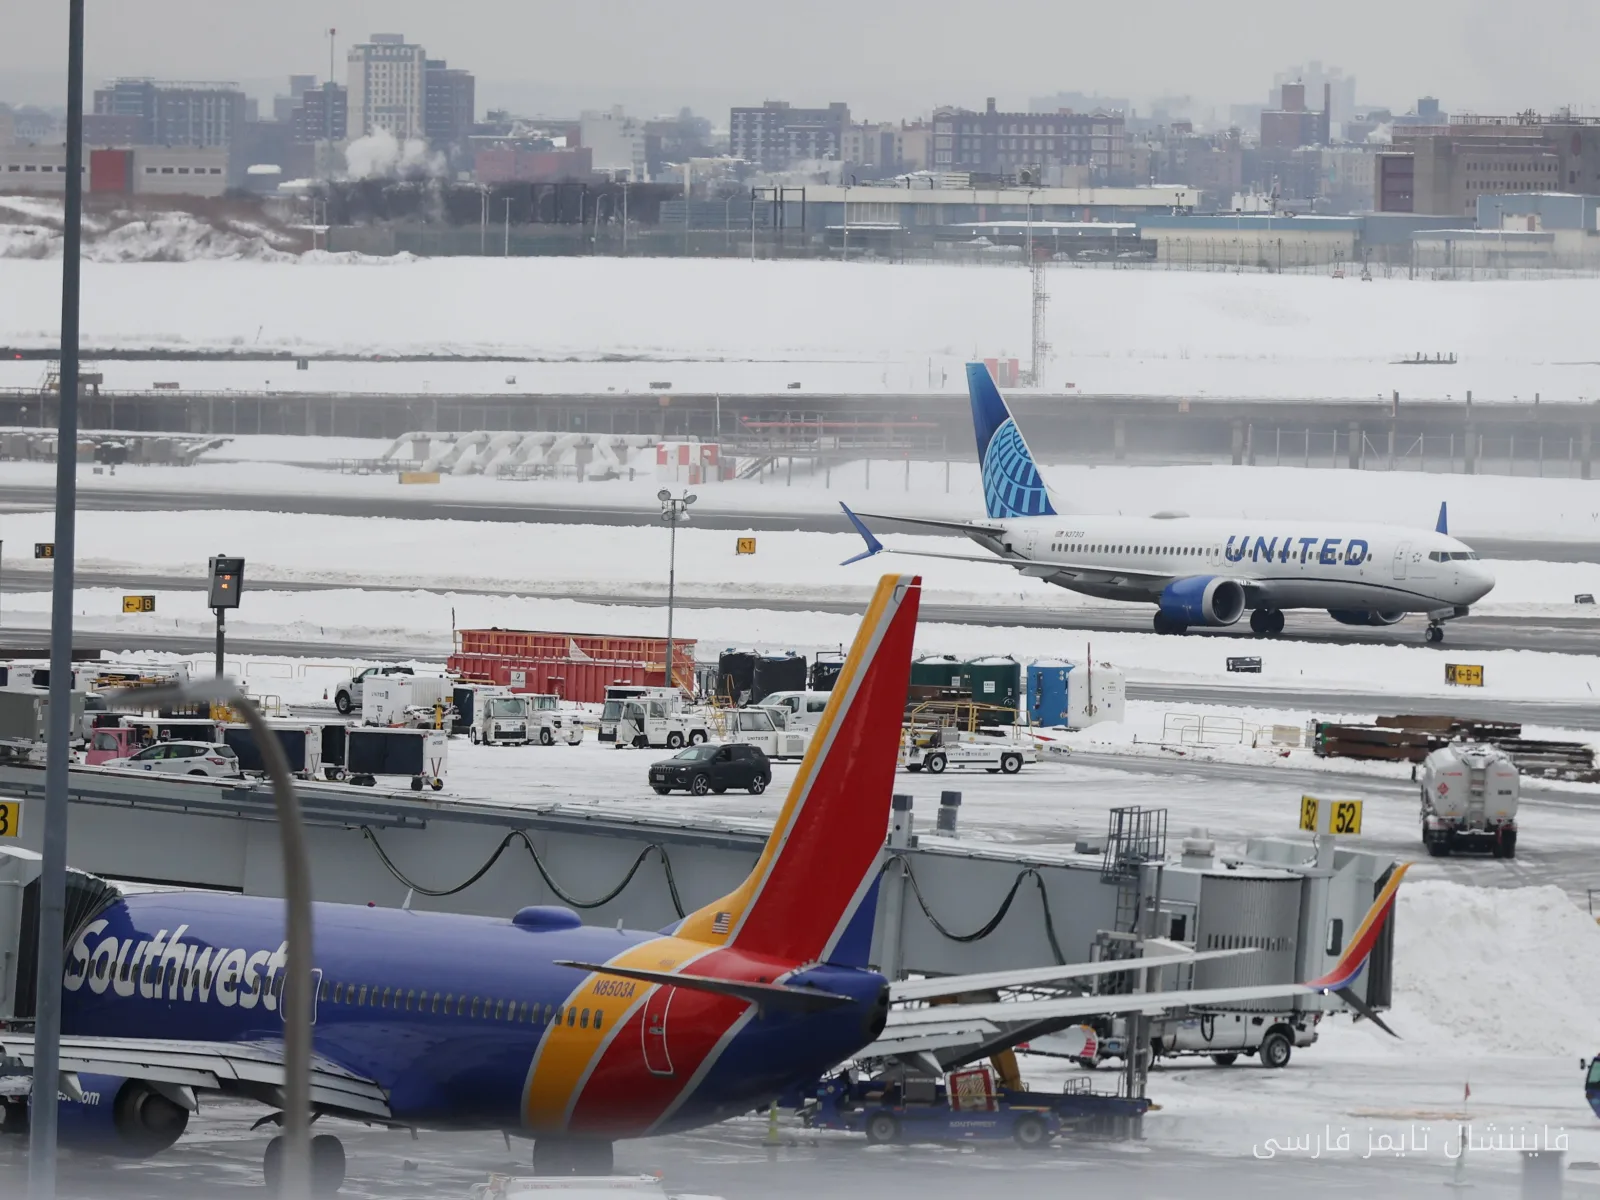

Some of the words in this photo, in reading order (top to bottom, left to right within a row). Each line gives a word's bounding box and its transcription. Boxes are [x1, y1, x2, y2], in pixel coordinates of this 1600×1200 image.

[1064, 530, 1085, 538] N37313
[44, 546, 52, 557] B
[1225, 535, 1368, 566] UNITED
[144, 599, 152, 610] B
[1466, 669, 1472, 681] B
[1305, 799, 1316, 831] 52
[1336, 803, 1356, 833] 52
[63, 919, 289, 1011] Southwest
[592, 979, 637, 998] N8503A
